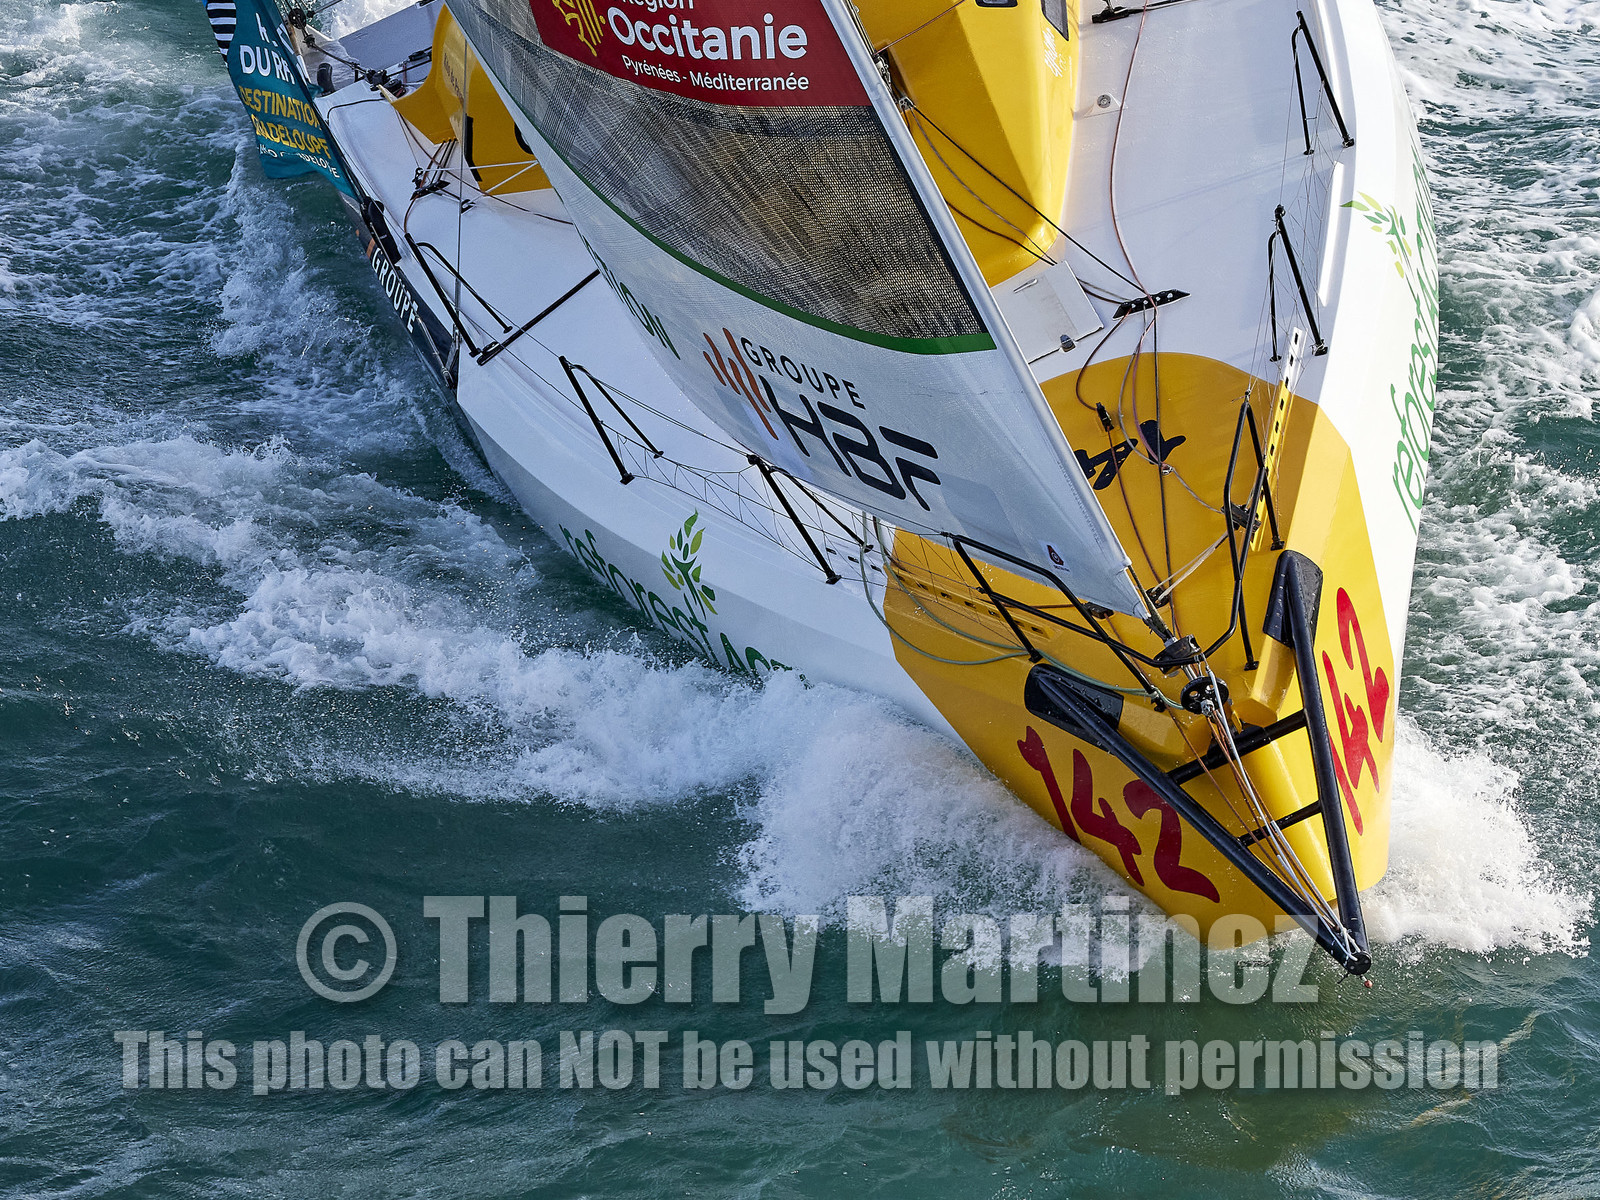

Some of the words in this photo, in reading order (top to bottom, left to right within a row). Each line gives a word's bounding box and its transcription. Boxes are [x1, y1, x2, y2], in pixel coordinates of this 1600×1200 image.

[239, 44, 271, 77] DU
[607, 6, 808, 60] Occitanie
[621, 54, 681, 83] Pyrénées
[689, 70, 809, 91] Méditerranée
[371, 247, 418, 334] GROUPE
[740, 336, 866, 410] GROUPE
[762, 375, 942, 512] HBF
[1322, 587, 1390, 837] 142
[1017, 725, 1221, 904] 142
